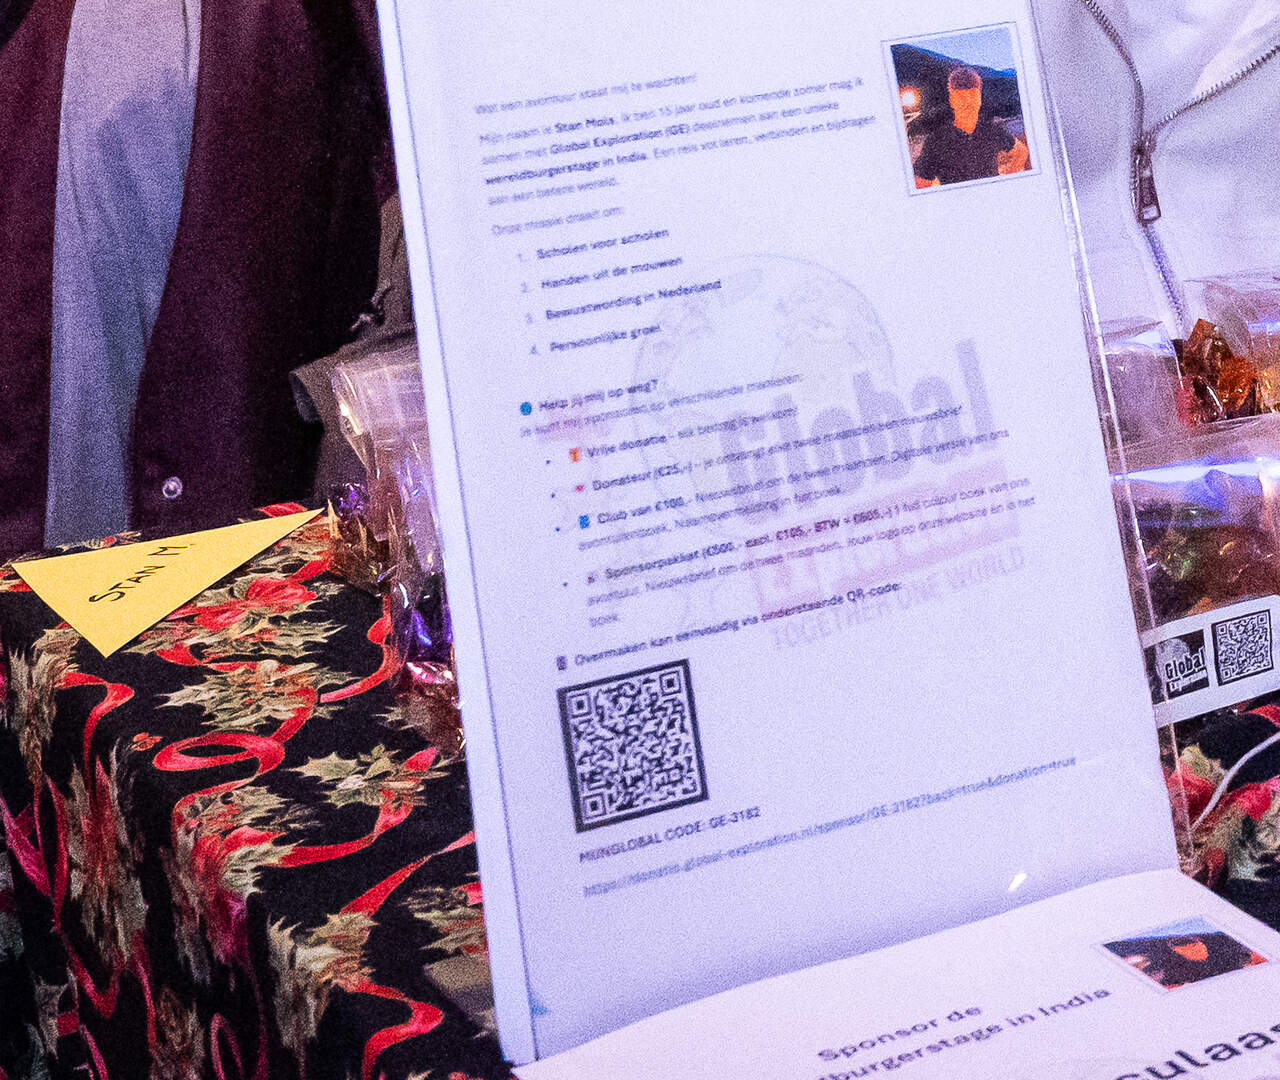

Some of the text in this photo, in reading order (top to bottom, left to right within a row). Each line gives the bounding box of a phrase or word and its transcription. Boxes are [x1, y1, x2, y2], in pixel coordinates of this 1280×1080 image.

[554, 120, 582, 132] Stan
[697, 99, 720, 110] oud
[739, 88, 790, 103] komende
[792, 83, 826, 95] zomer
[549, 139, 590, 153] Global
[592, 128, 662, 146] Exploration
[485, 159, 600, 184] wereldburgerstage
[536, 242, 587, 258] Scholen
[590, 237, 616, 249] voor
[620, 228, 669, 244] scholen
[540, 273, 589, 289] Handen
[592, 270, 608, 280] uit
[630, 256, 683, 273] mouwen
[545, 294, 641, 319] Bewustwording
[658, 279, 722, 298] Nederland
[549, 329, 627, 351] Persoonlijke
[630, 323, 661, 336] groei
[538, 397, 568, 411] Help
[626, 379, 659, 394] weg?
[716, 341, 1001, 520] Global
[591, 470, 651, 490] Donateur
[597, 509, 627, 524] Club
[630, 504, 652, 517] van
[988, 427, 1009, 440] ons
[605, 549, 700, 579] Sponsorpakket
[814, 518, 840, 532] BTW
[942, 543, 1028, 593] WORLD
[89, 565, 166, 603] STAN
[574, 640, 646, 665] Overmaken
[649, 634, 672, 648] kan
[674, 618, 740, 641] eenvoudig
[741, 614, 758, 626] via
[761, 594, 844, 621] onderstaande
[1164, 645, 1206, 680] Global
[818, 987, 1112, 1080] burgerstage in India
[818, 1006, 981, 1062] Sponsor de
